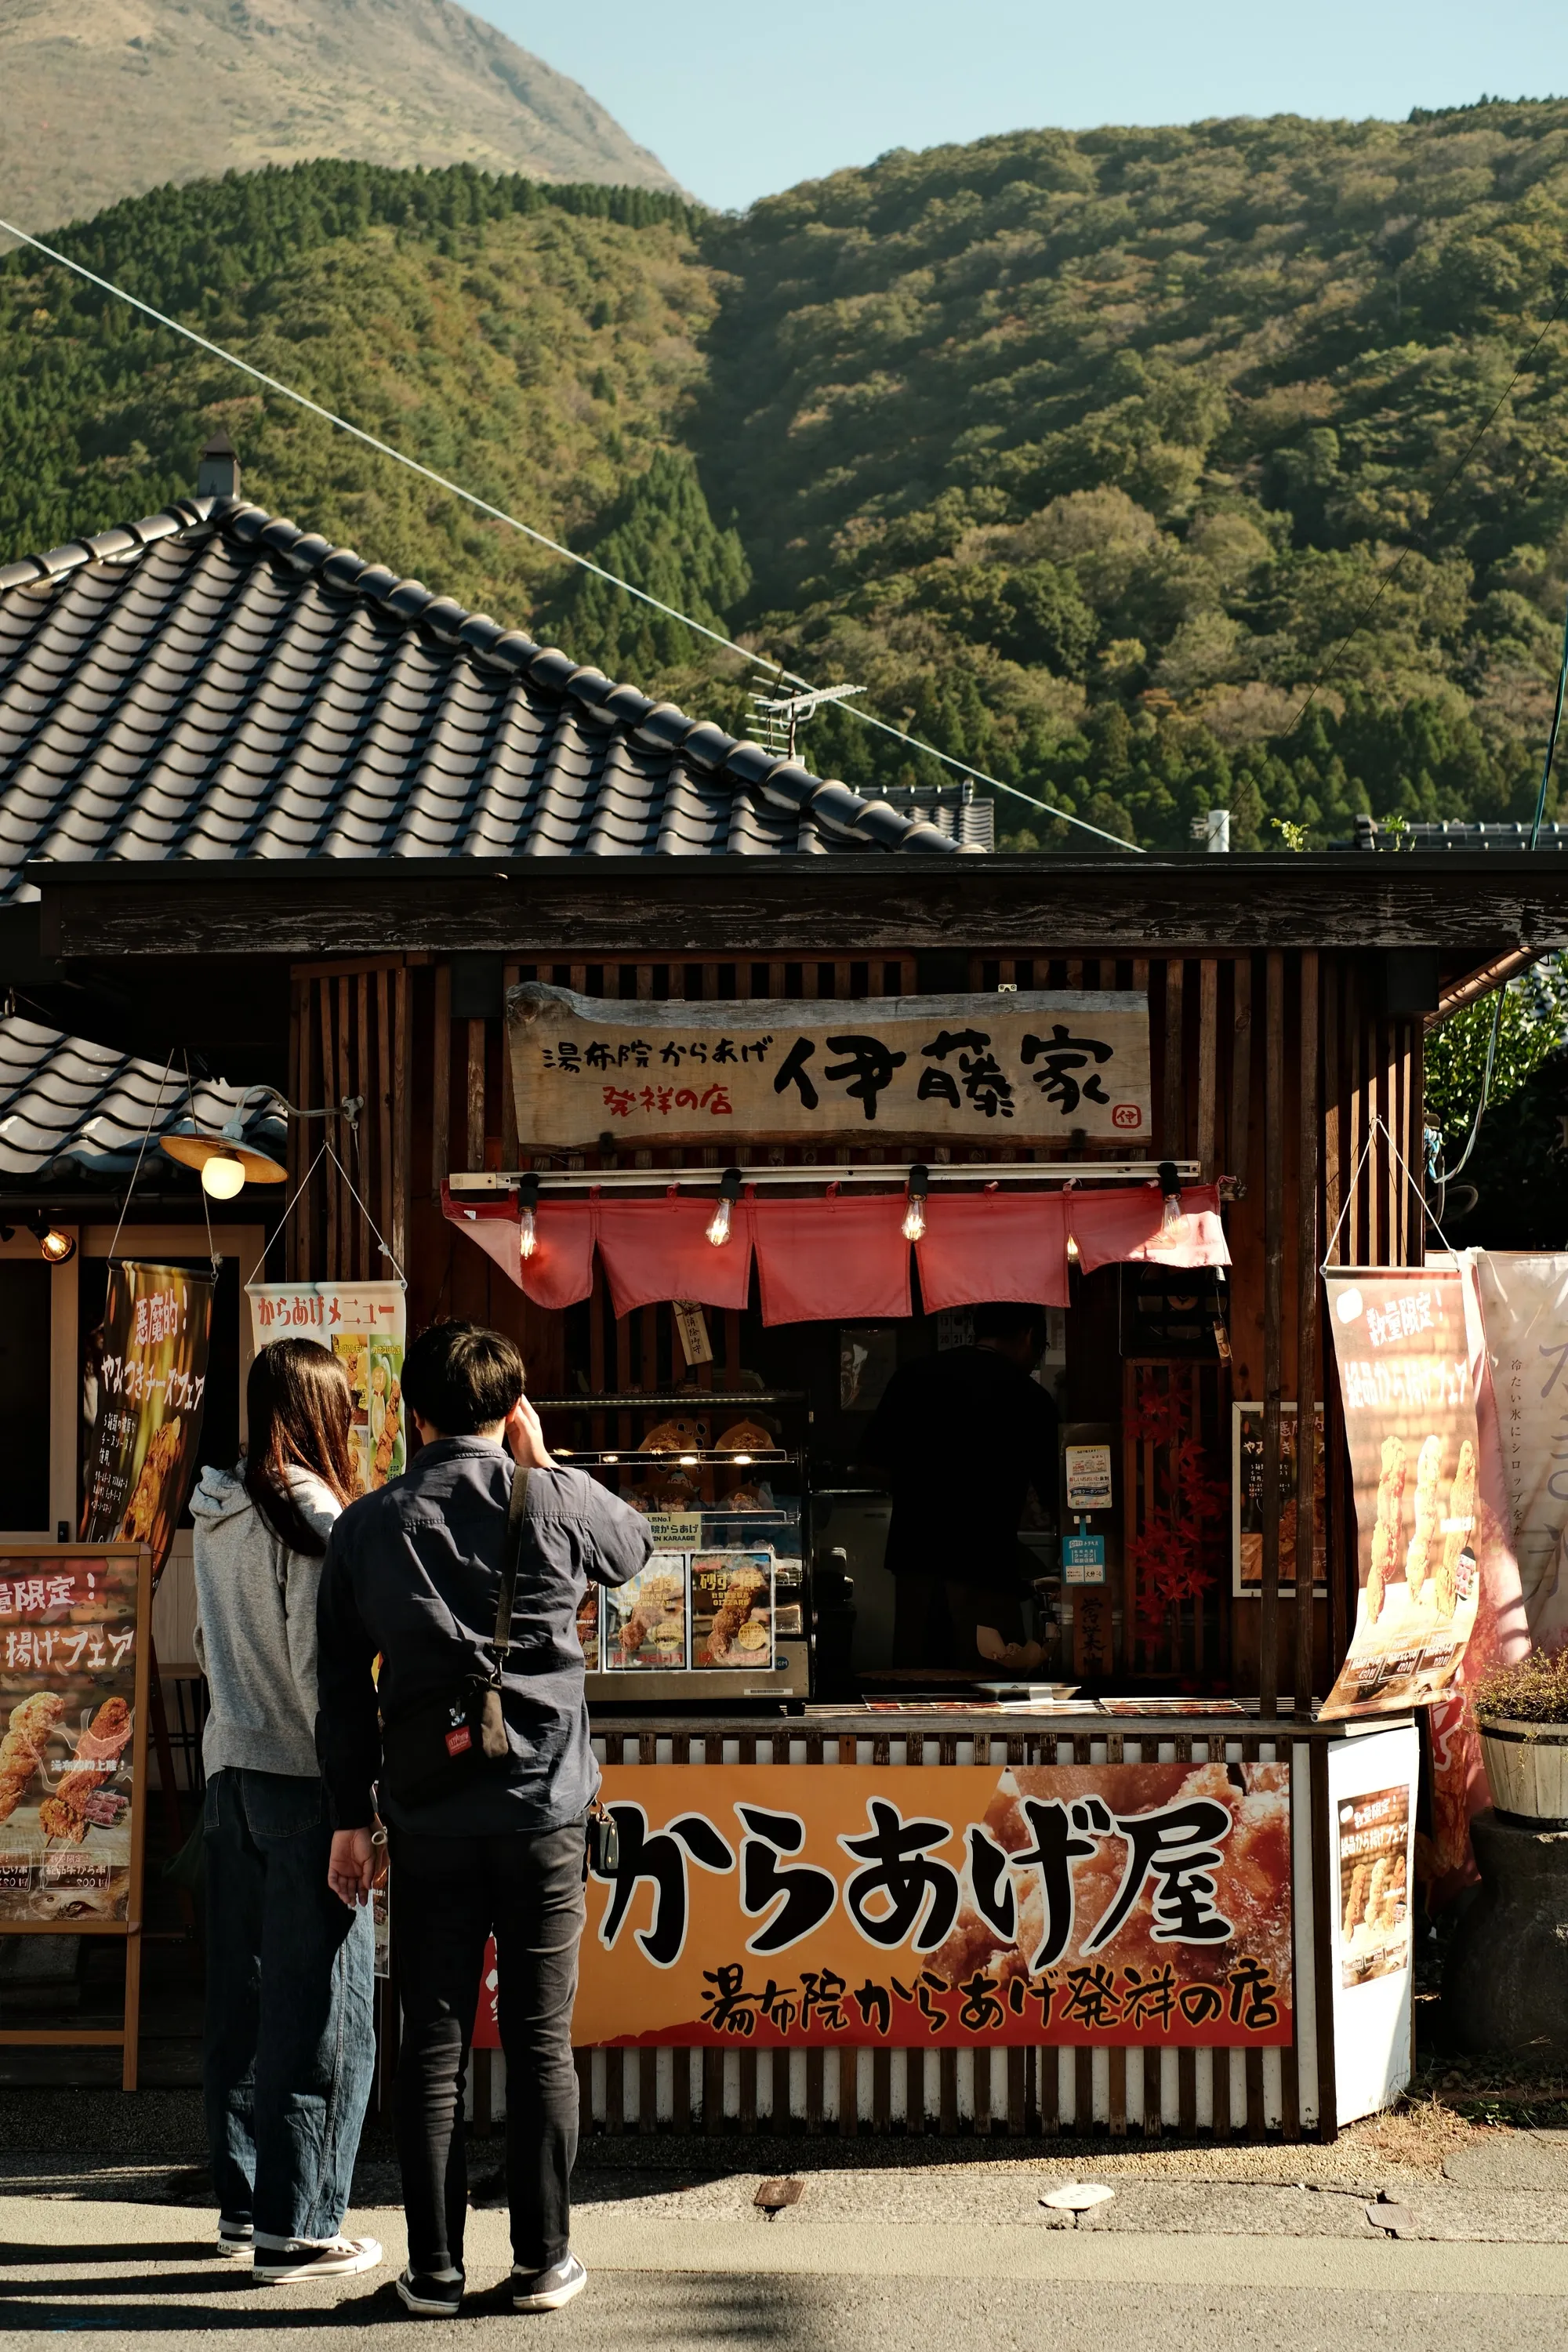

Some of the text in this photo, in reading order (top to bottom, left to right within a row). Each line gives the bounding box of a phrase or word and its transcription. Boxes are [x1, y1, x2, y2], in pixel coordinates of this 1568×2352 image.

[542, 1035, 773, 1073] 湯布院からあげ
[773, 1024, 1113, 1120] 伊藤家
[602, 1083, 733, 1117] 発祥の店
[257, 1295, 395, 1327] からあげメニュー
[954, 1334, 963, 1344] 21
[101, 1354, 205, 1410] やみつきチーズフェア
[592, 1795, 1236, 1974] からあげ屋
[700, 1957, 1281, 2038] 湯布院からあげ発祥の店
